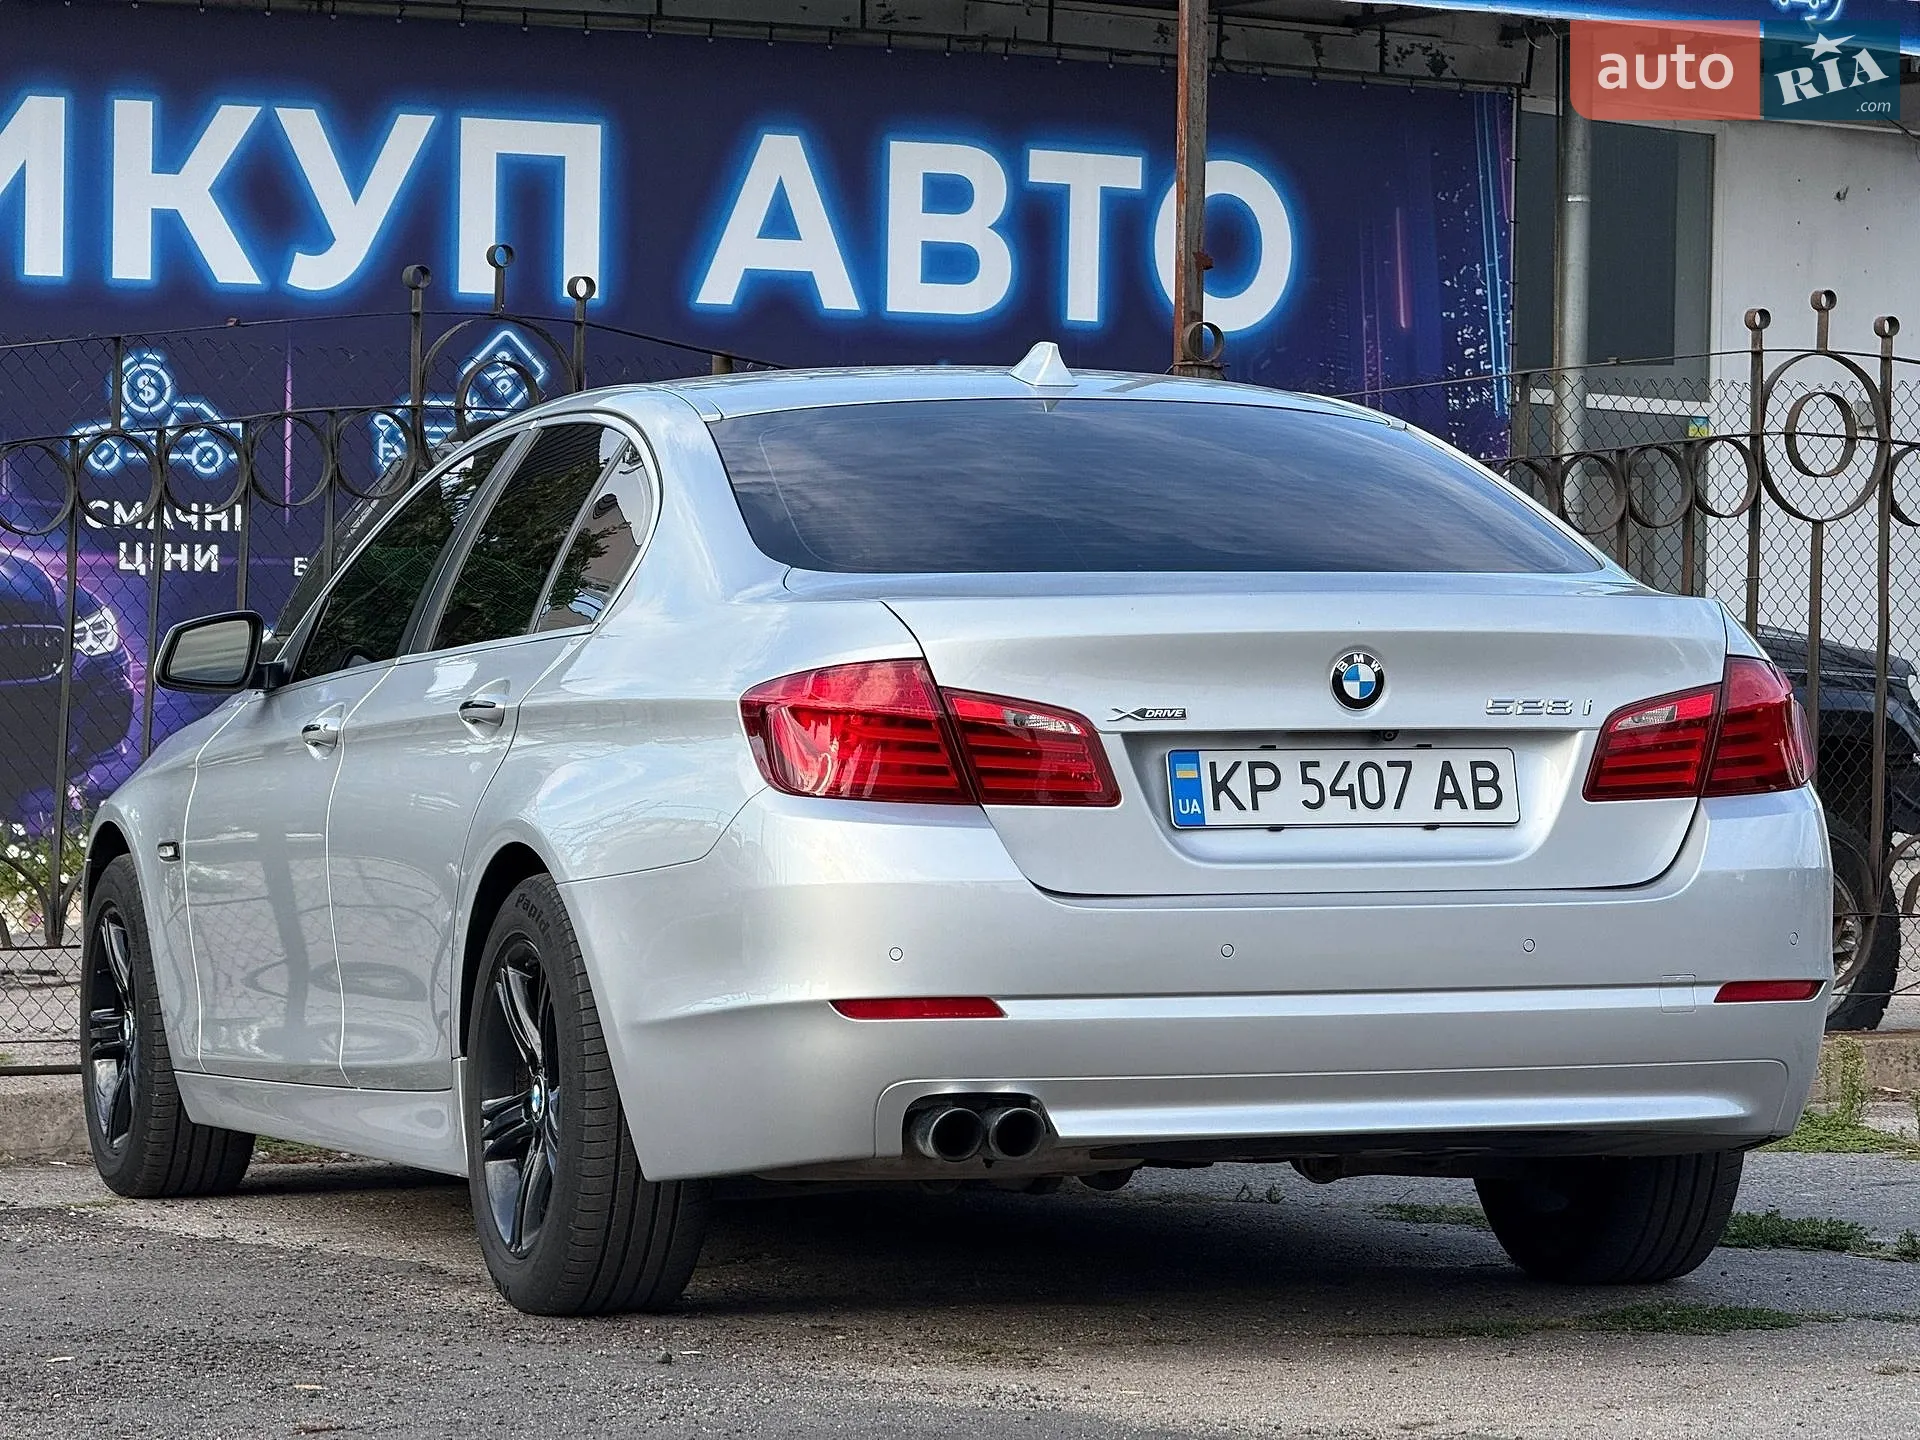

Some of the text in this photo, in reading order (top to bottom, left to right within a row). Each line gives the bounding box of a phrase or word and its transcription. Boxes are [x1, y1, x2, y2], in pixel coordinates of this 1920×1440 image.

[696, 133, 1292, 333] АВТО
[84, 500, 242, 532] СМАЧНІ
[1336, 653, 1382, 673] BMW
[1209, 760, 1504, 811] KP 5407 AB
[1178, 799, 1202, 815] UA
